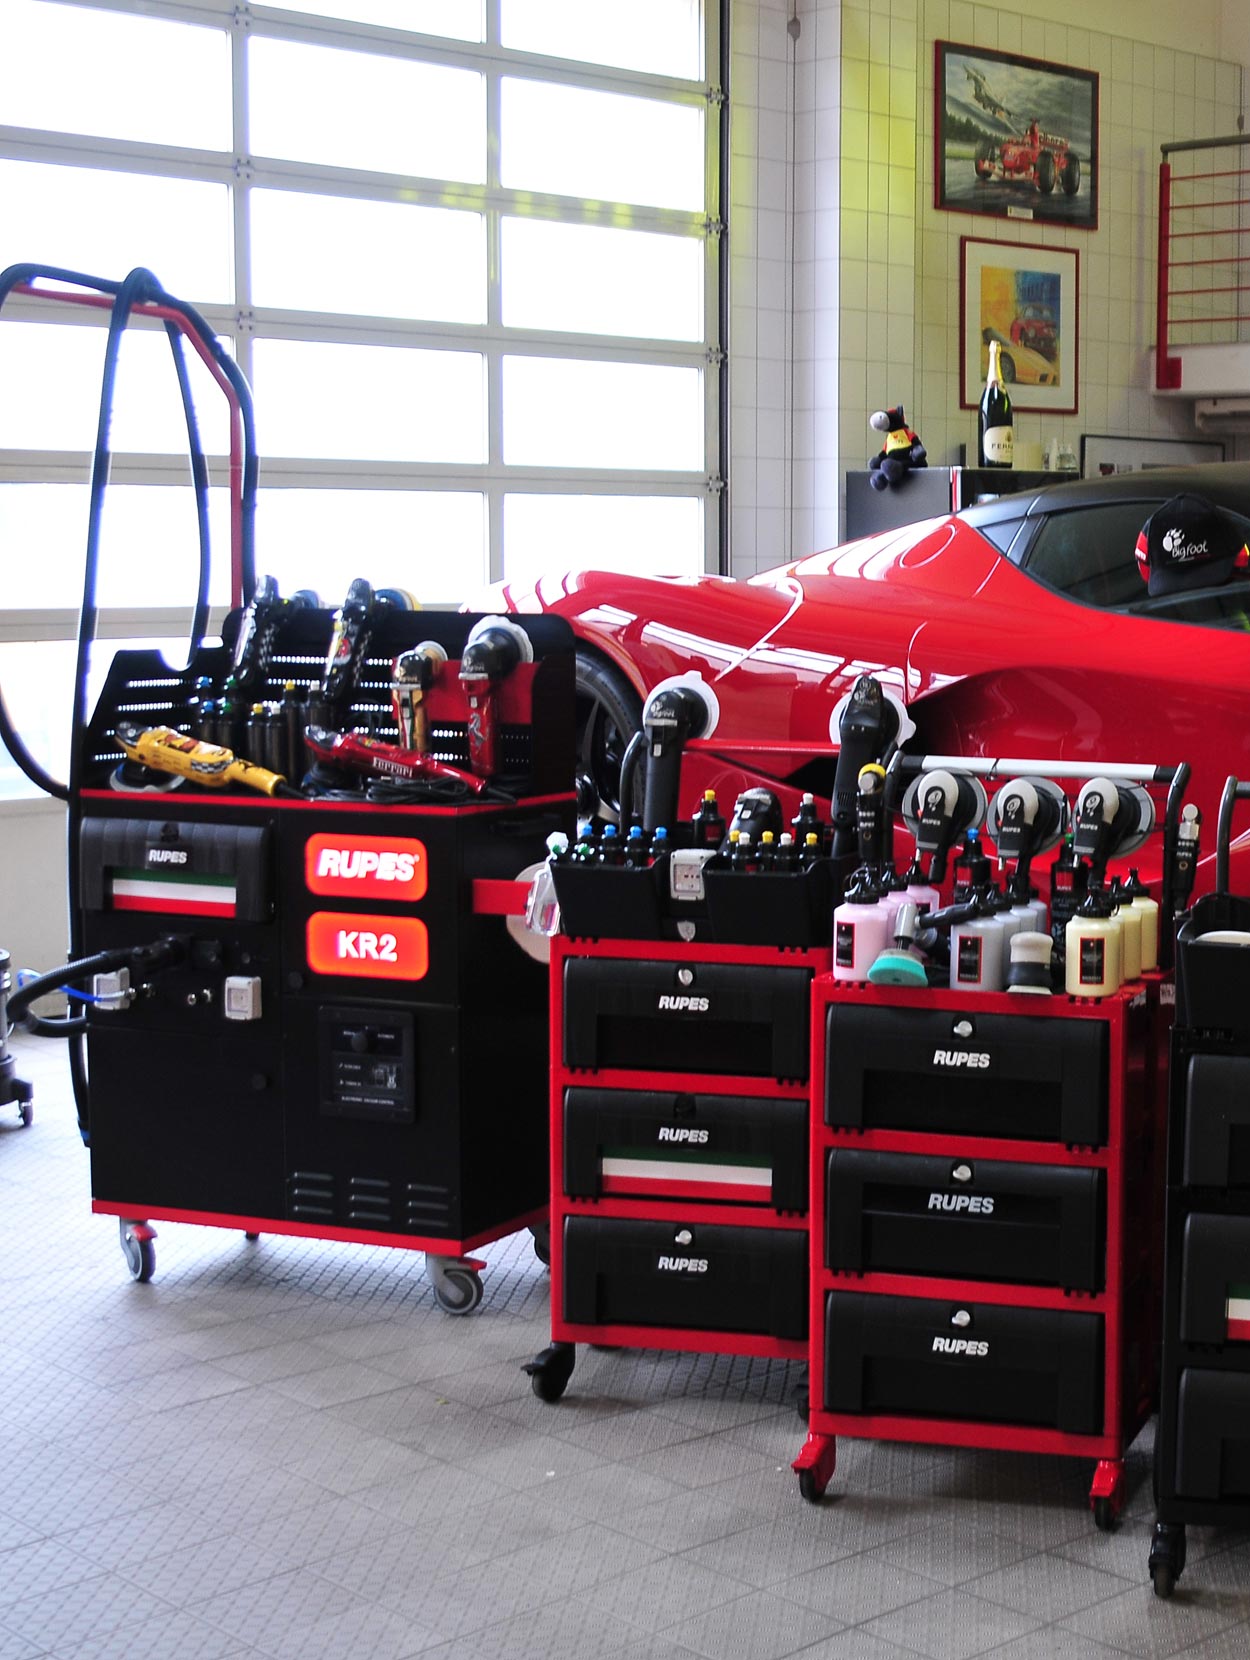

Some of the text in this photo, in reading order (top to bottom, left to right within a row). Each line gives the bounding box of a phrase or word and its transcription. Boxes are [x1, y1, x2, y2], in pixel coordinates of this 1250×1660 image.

[373, 757, 413, 778] Ferrari
[149, 849, 187, 864] RUPES
[337, 930, 398, 962] KR2
[658, 995, 709, 1011] RUPES
[933, 1050, 990, 1068] RUPES
[658, 1127, 709, 1143] RUPES
[928, 1193, 994, 1214] RUPES
[657, 1256, 708, 1272] RUPES
[932, 1337, 989, 1356] RUPES
